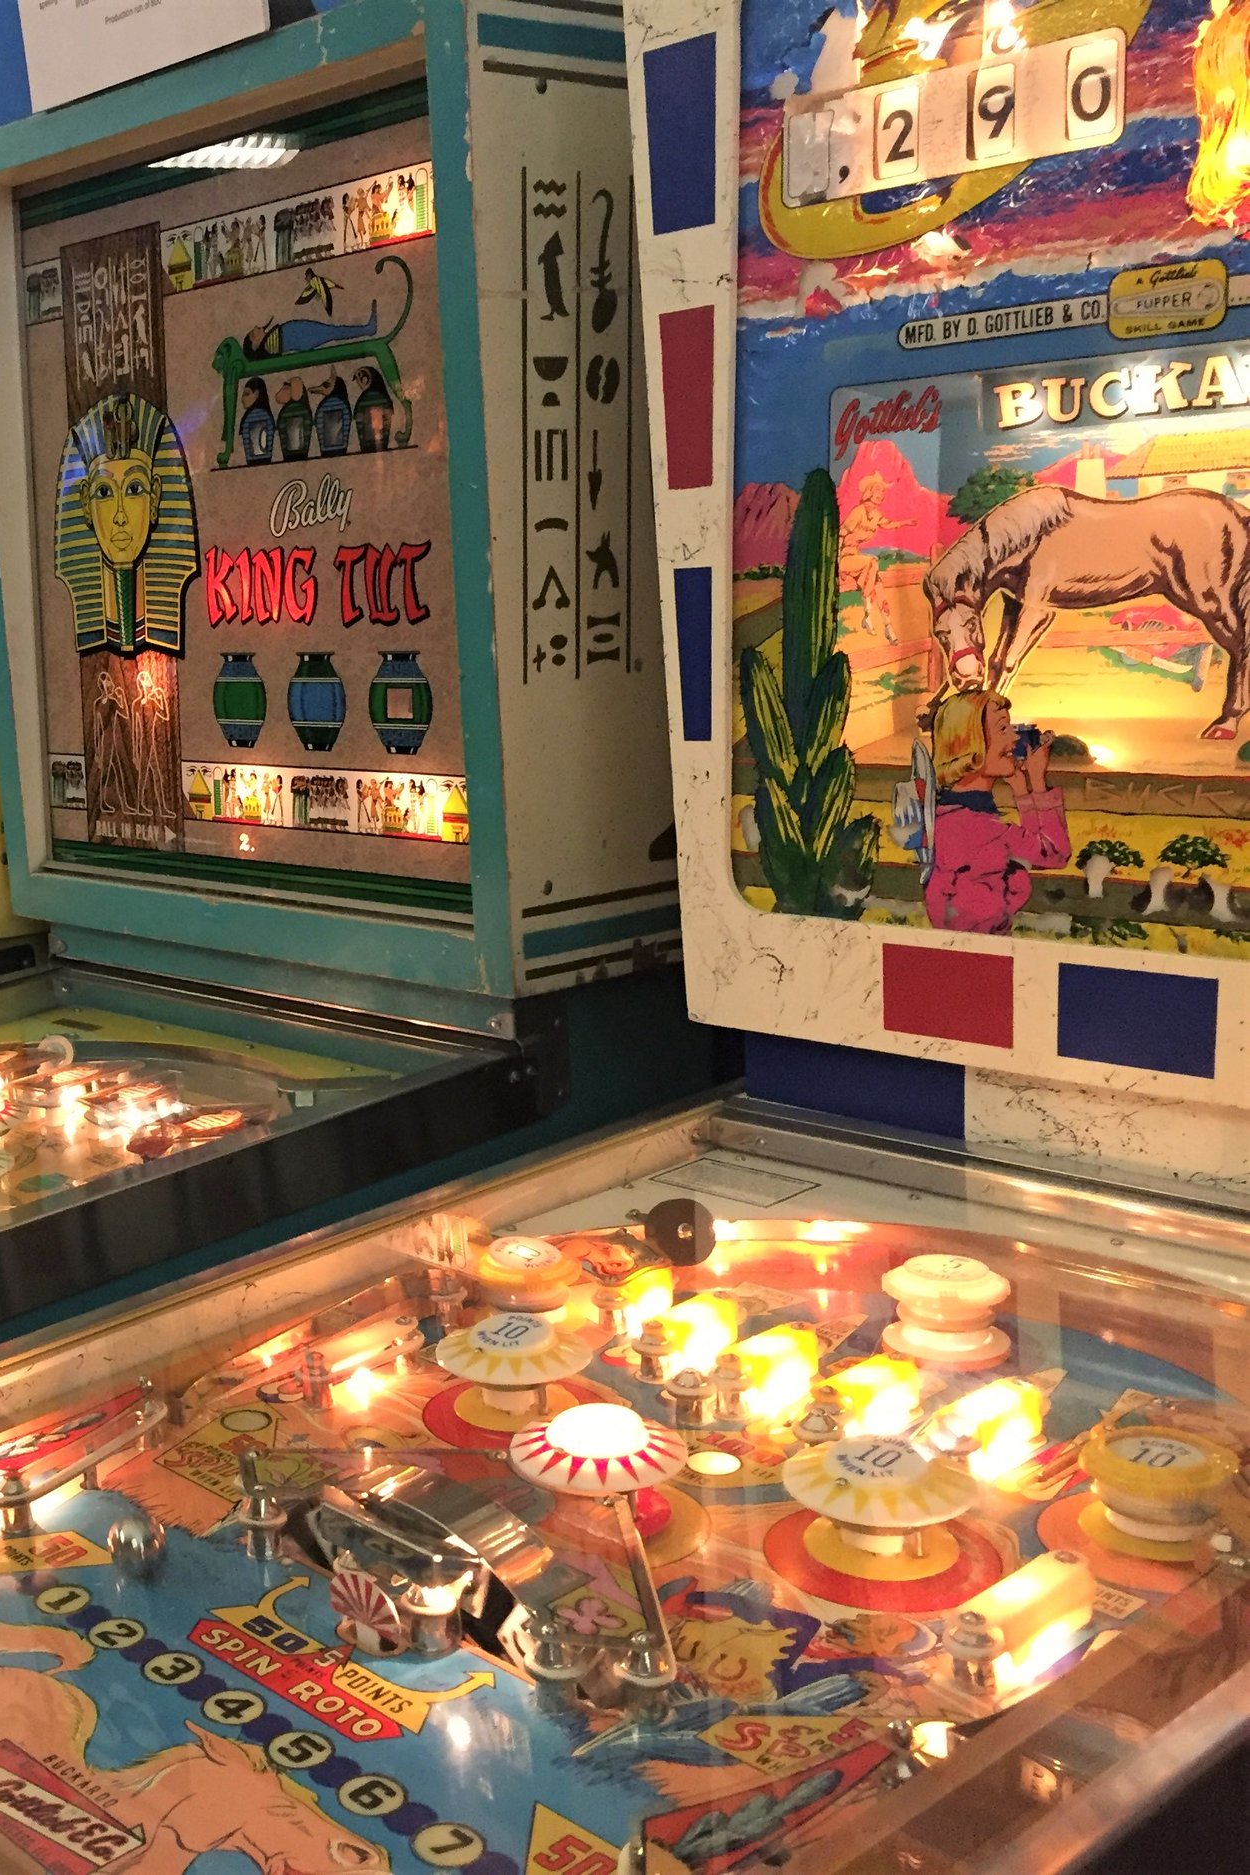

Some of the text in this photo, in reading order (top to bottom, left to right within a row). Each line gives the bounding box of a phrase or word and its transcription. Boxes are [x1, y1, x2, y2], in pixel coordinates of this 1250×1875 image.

[882, 109, 916, 164] 2
[978, 85, 1015, 139] 9
[904, 322, 937, 344] MFD.
[943, 317, 961, 339] BY
[967, 317, 979, 336] D.
[985, 306, 1054, 334] GOTTLIEB
[1062, 303, 1073, 323] &
[1125, 317, 1205, 335] SKILL GAME
[993, 355, 1250, 431] BUCKA
[834, 385, 943, 461] Gottlieb's
[269, 473, 354, 538] Bally
[204, 539, 433, 628] KING TUT
[96, 820, 118, 838] BALL
[121, 823, 132, 839] IN
[136, 823, 161, 841] PLAY
[476, 1330, 499, 1346] WHEN
[490, 1322, 530, 1339] 10
[836, 1453, 866, 1476] WHEN
[854, 1444, 902, 1468] 10
[1128, 1447, 1176, 1468] 10
[188, 1469, 222, 1487] WHEN
[4, 1545, 34, 1567] POINTS
[29, 1535, 88, 1568] 50
[44, 1590, 81, 1611] 1
[96, 1621, 139, 1647] 2
[151, 1654, 195, 1683] 3
[241, 1614, 414, 1715] 50 POINTS
[200, 1628, 383, 1738] SPIN ROTO
[213, 1698, 255, 1720] 4
[277, 1734, 325, 1766] 5
[41, 1753, 119, 1809] BUCKAROO
[348, 1779, 395, 1810] 6
[429, 1829, 474, 1855] 7
